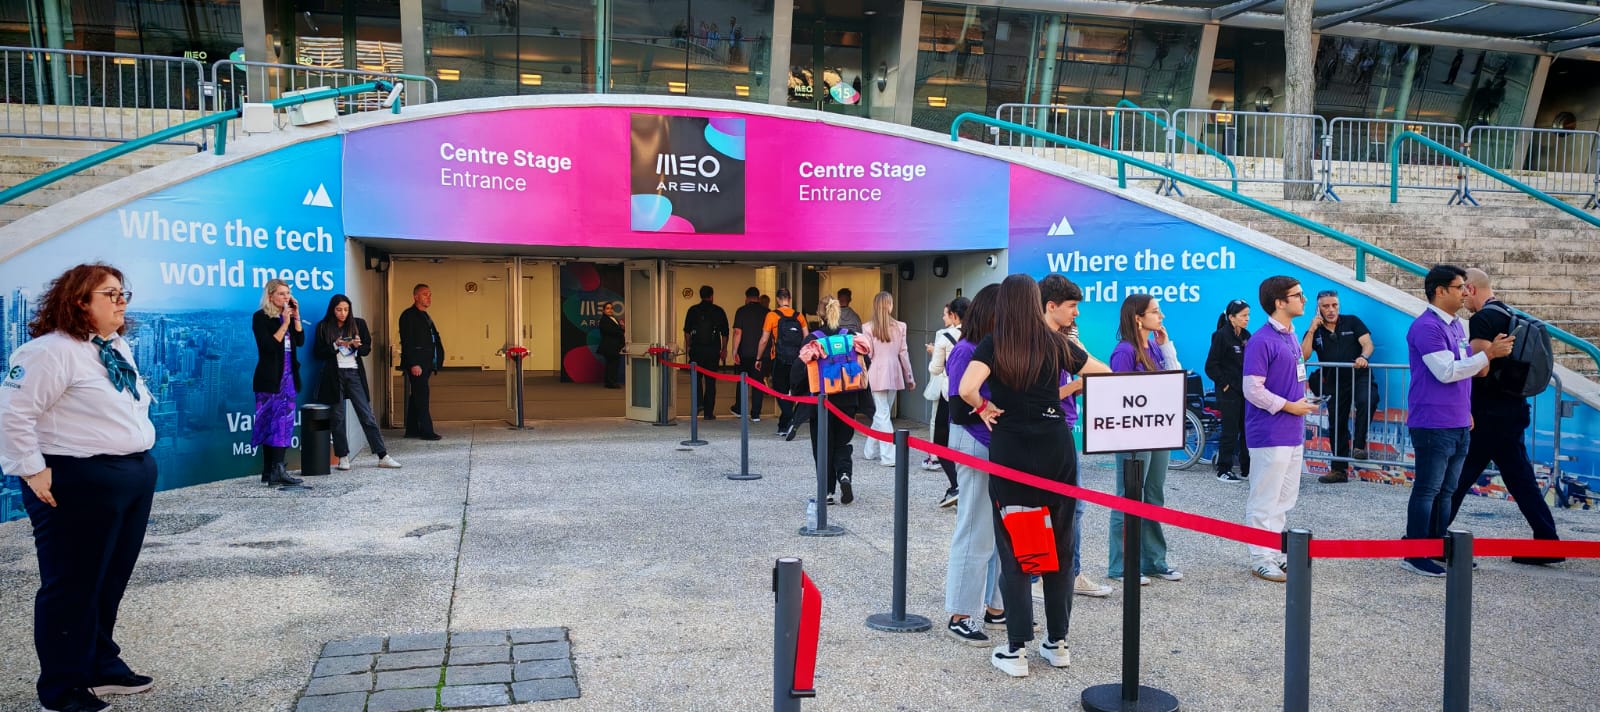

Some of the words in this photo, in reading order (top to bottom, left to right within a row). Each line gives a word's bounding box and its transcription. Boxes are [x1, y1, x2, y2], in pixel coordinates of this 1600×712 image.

[838, 87, 851, 99] 15
[440, 142, 509, 165] Centre
[513, 149, 572, 174] Stage
[656, 153, 720, 178] MEO
[441, 167, 527, 191] Entrance
[799, 161, 865, 178] Centre
[869, 161, 926, 181] Stage
[656, 181, 720, 193] ARENA
[799, 184, 882, 201] Entrance
[118, 208, 217, 245] Where
[225, 218, 269, 249] the
[275, 225, 333, 253] tech
[1046, 251, 1128, 272] Where
[1134, 248, 1175, 271] the
[1181, 246, 1236, 270] tech
[159, 258, 245, 288] world
[1080, 281, 1118, 303] rld
[1122, 394, 1148, 409] NO
[1093, 413, 1176, 430] RE-ENTRY
[232, 441, 258, 457] May
